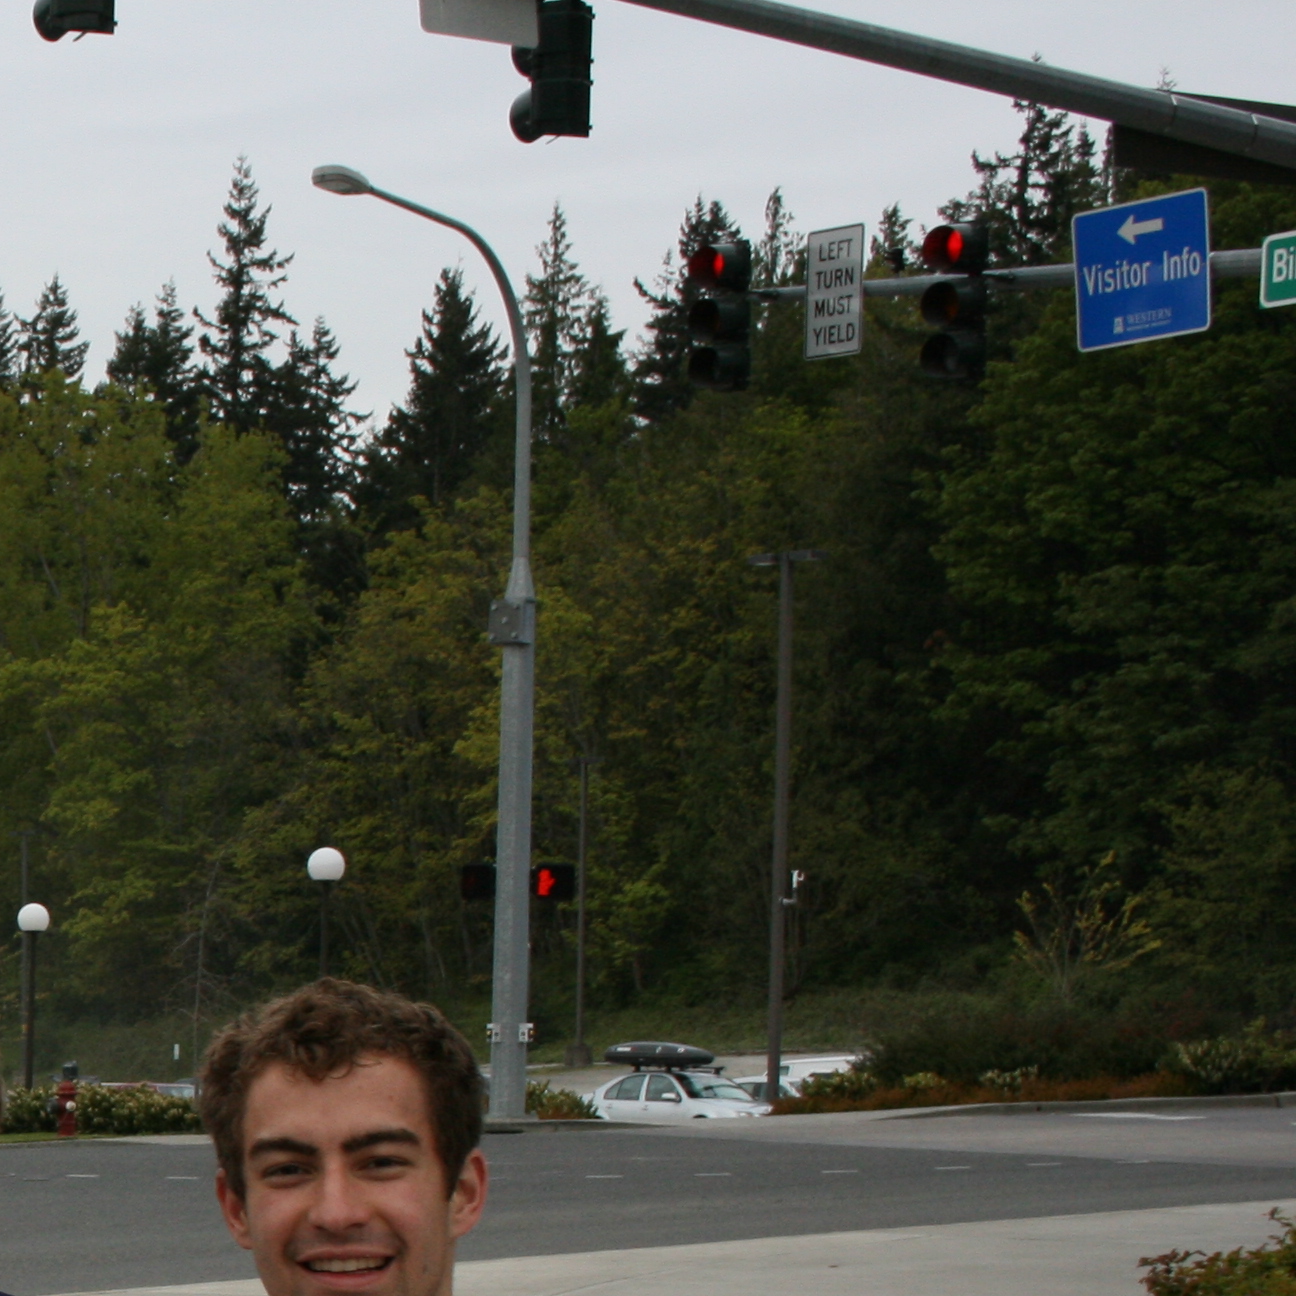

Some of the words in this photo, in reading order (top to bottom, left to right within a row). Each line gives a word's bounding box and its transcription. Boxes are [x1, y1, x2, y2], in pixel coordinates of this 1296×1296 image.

[819, 239, 853, 262] LEFT
[1083, 260, 1151, 296] Visitor
[1162, 246, 1202, 282] Info
[1272, 246, 1296, 283] Bi
[816, 267, 854, 290] TURN
[814, 295, 853, 318] MUST
[813, 323, 855, 346] YIELD
